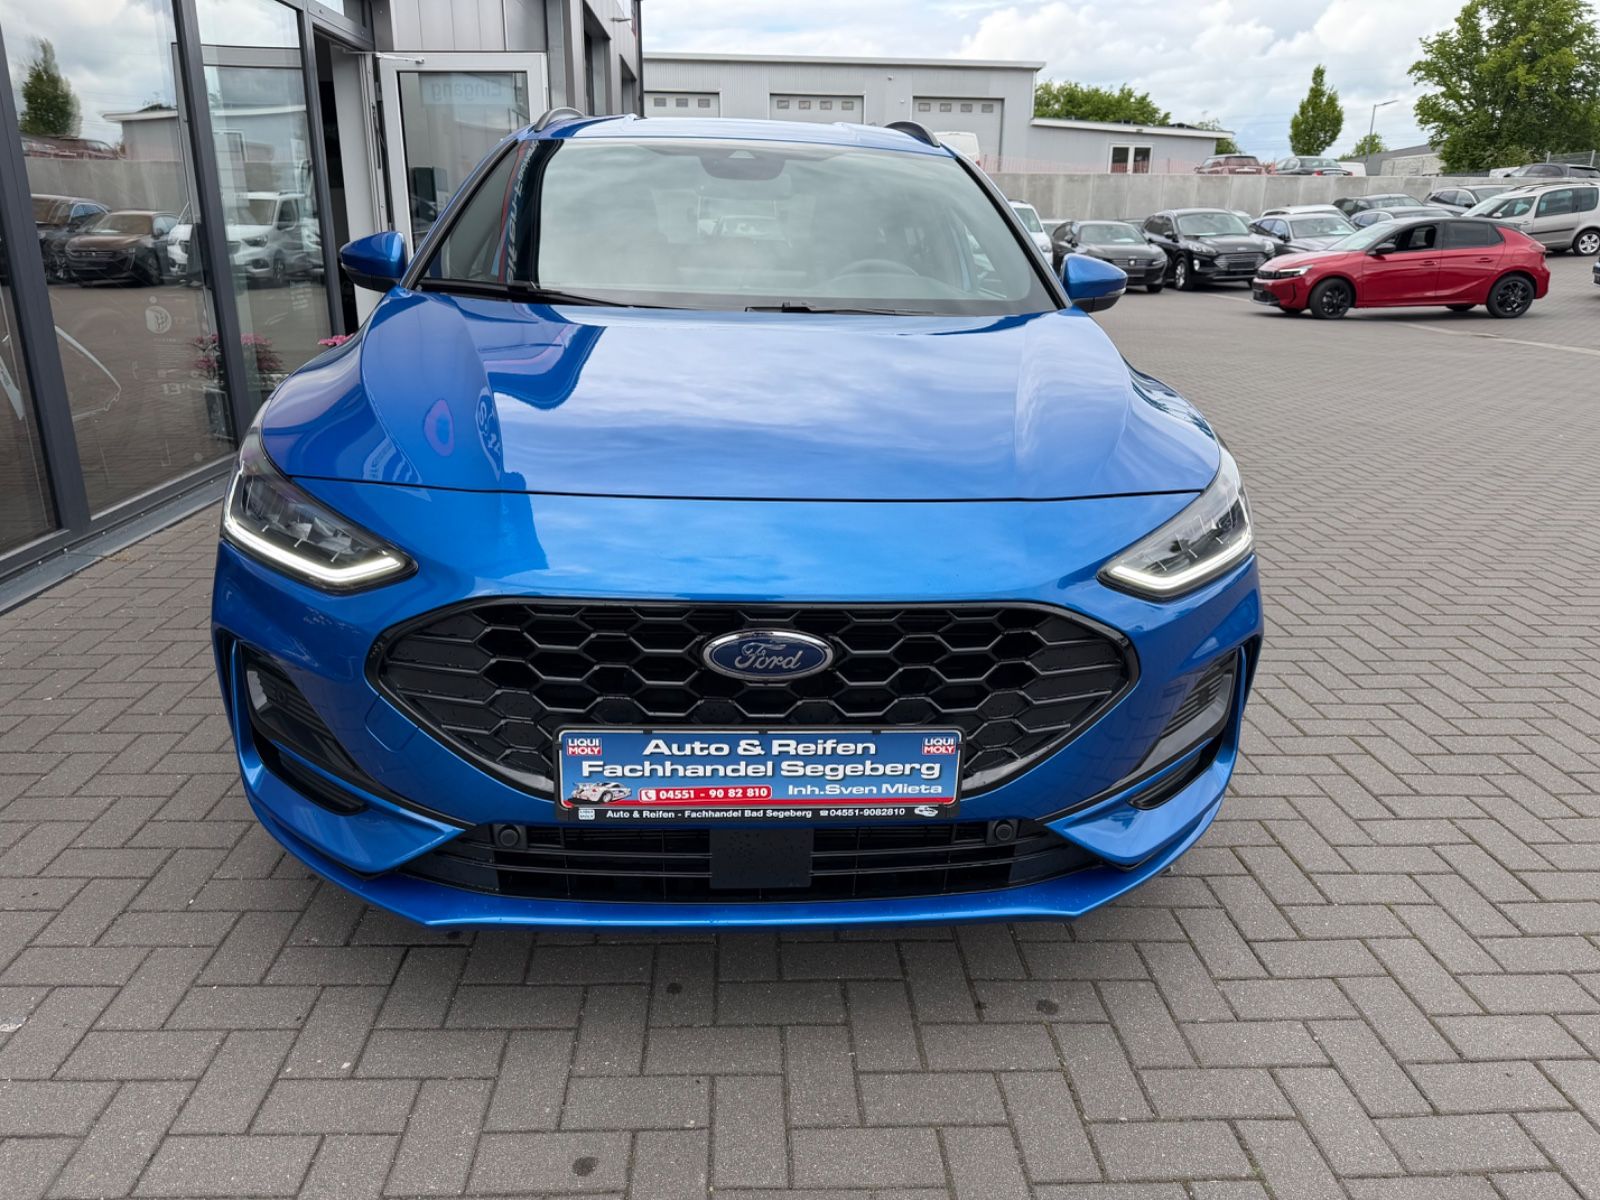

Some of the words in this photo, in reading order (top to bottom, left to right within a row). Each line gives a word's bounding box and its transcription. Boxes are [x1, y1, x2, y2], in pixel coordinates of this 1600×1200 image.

[734, 642, 804, 669] Ford
[568, 737, 600, 747] LIQUI
[924, 737, 955, 746] LIQUI
[568, 746, 602, 755] MOLY
[642, 739, 730, 756] Auto
[737, 739, 766, 756] &
[771, 739, 876, 756] Reifen
[923, 745, 956, 755] MOLY
[582, 760, 773, 777] Fachhandel
[780, 760, 941, 780] Segeberg
[659, 789, 695, 800] 04551
[709, 789, 724, 799] 90
[728, 788, 743, 798] 82
[746, 787, 768, 798] 810
[881, 783, 942, 794] Mieta
[606, 810, 630, 819] Auto
[632, 810, 641, 819] &
[643, 810, 675, 819] Reifen
[684, 809, 741, 818] Fachhandel
[744, 809, 764, 818] Bad
[766, 809, 812, 819] Segeberg
[829, 808, 906, 817] 04551-9082810
